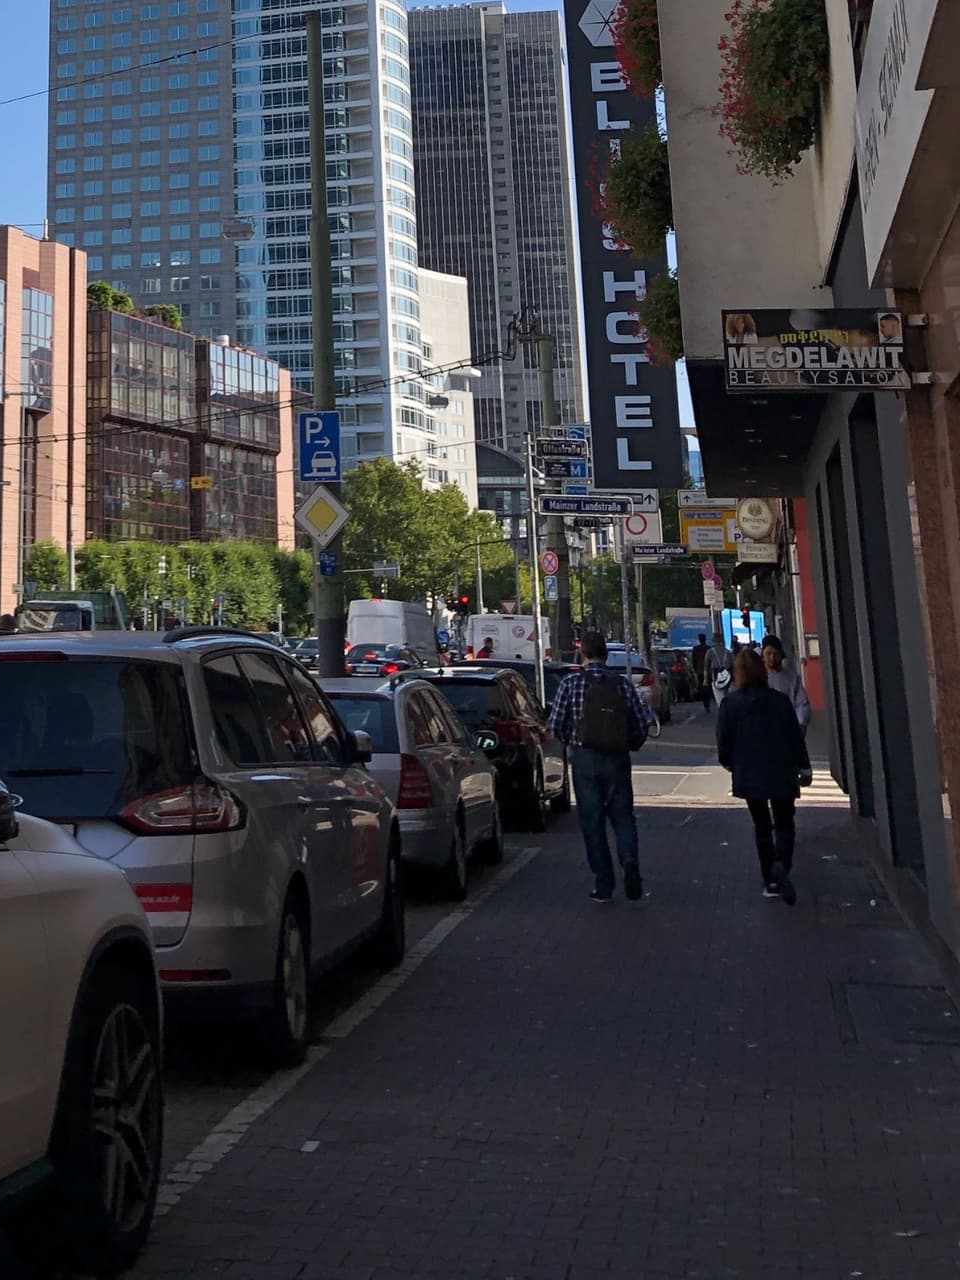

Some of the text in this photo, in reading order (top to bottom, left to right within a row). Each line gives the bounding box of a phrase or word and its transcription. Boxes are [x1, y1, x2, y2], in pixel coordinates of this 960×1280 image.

[727, 346, 903, 369] MEGDELAWIT
[602, 269, 653, 471] HOTEL
[549, 500, 621, 512] Mainzer Landstraße
